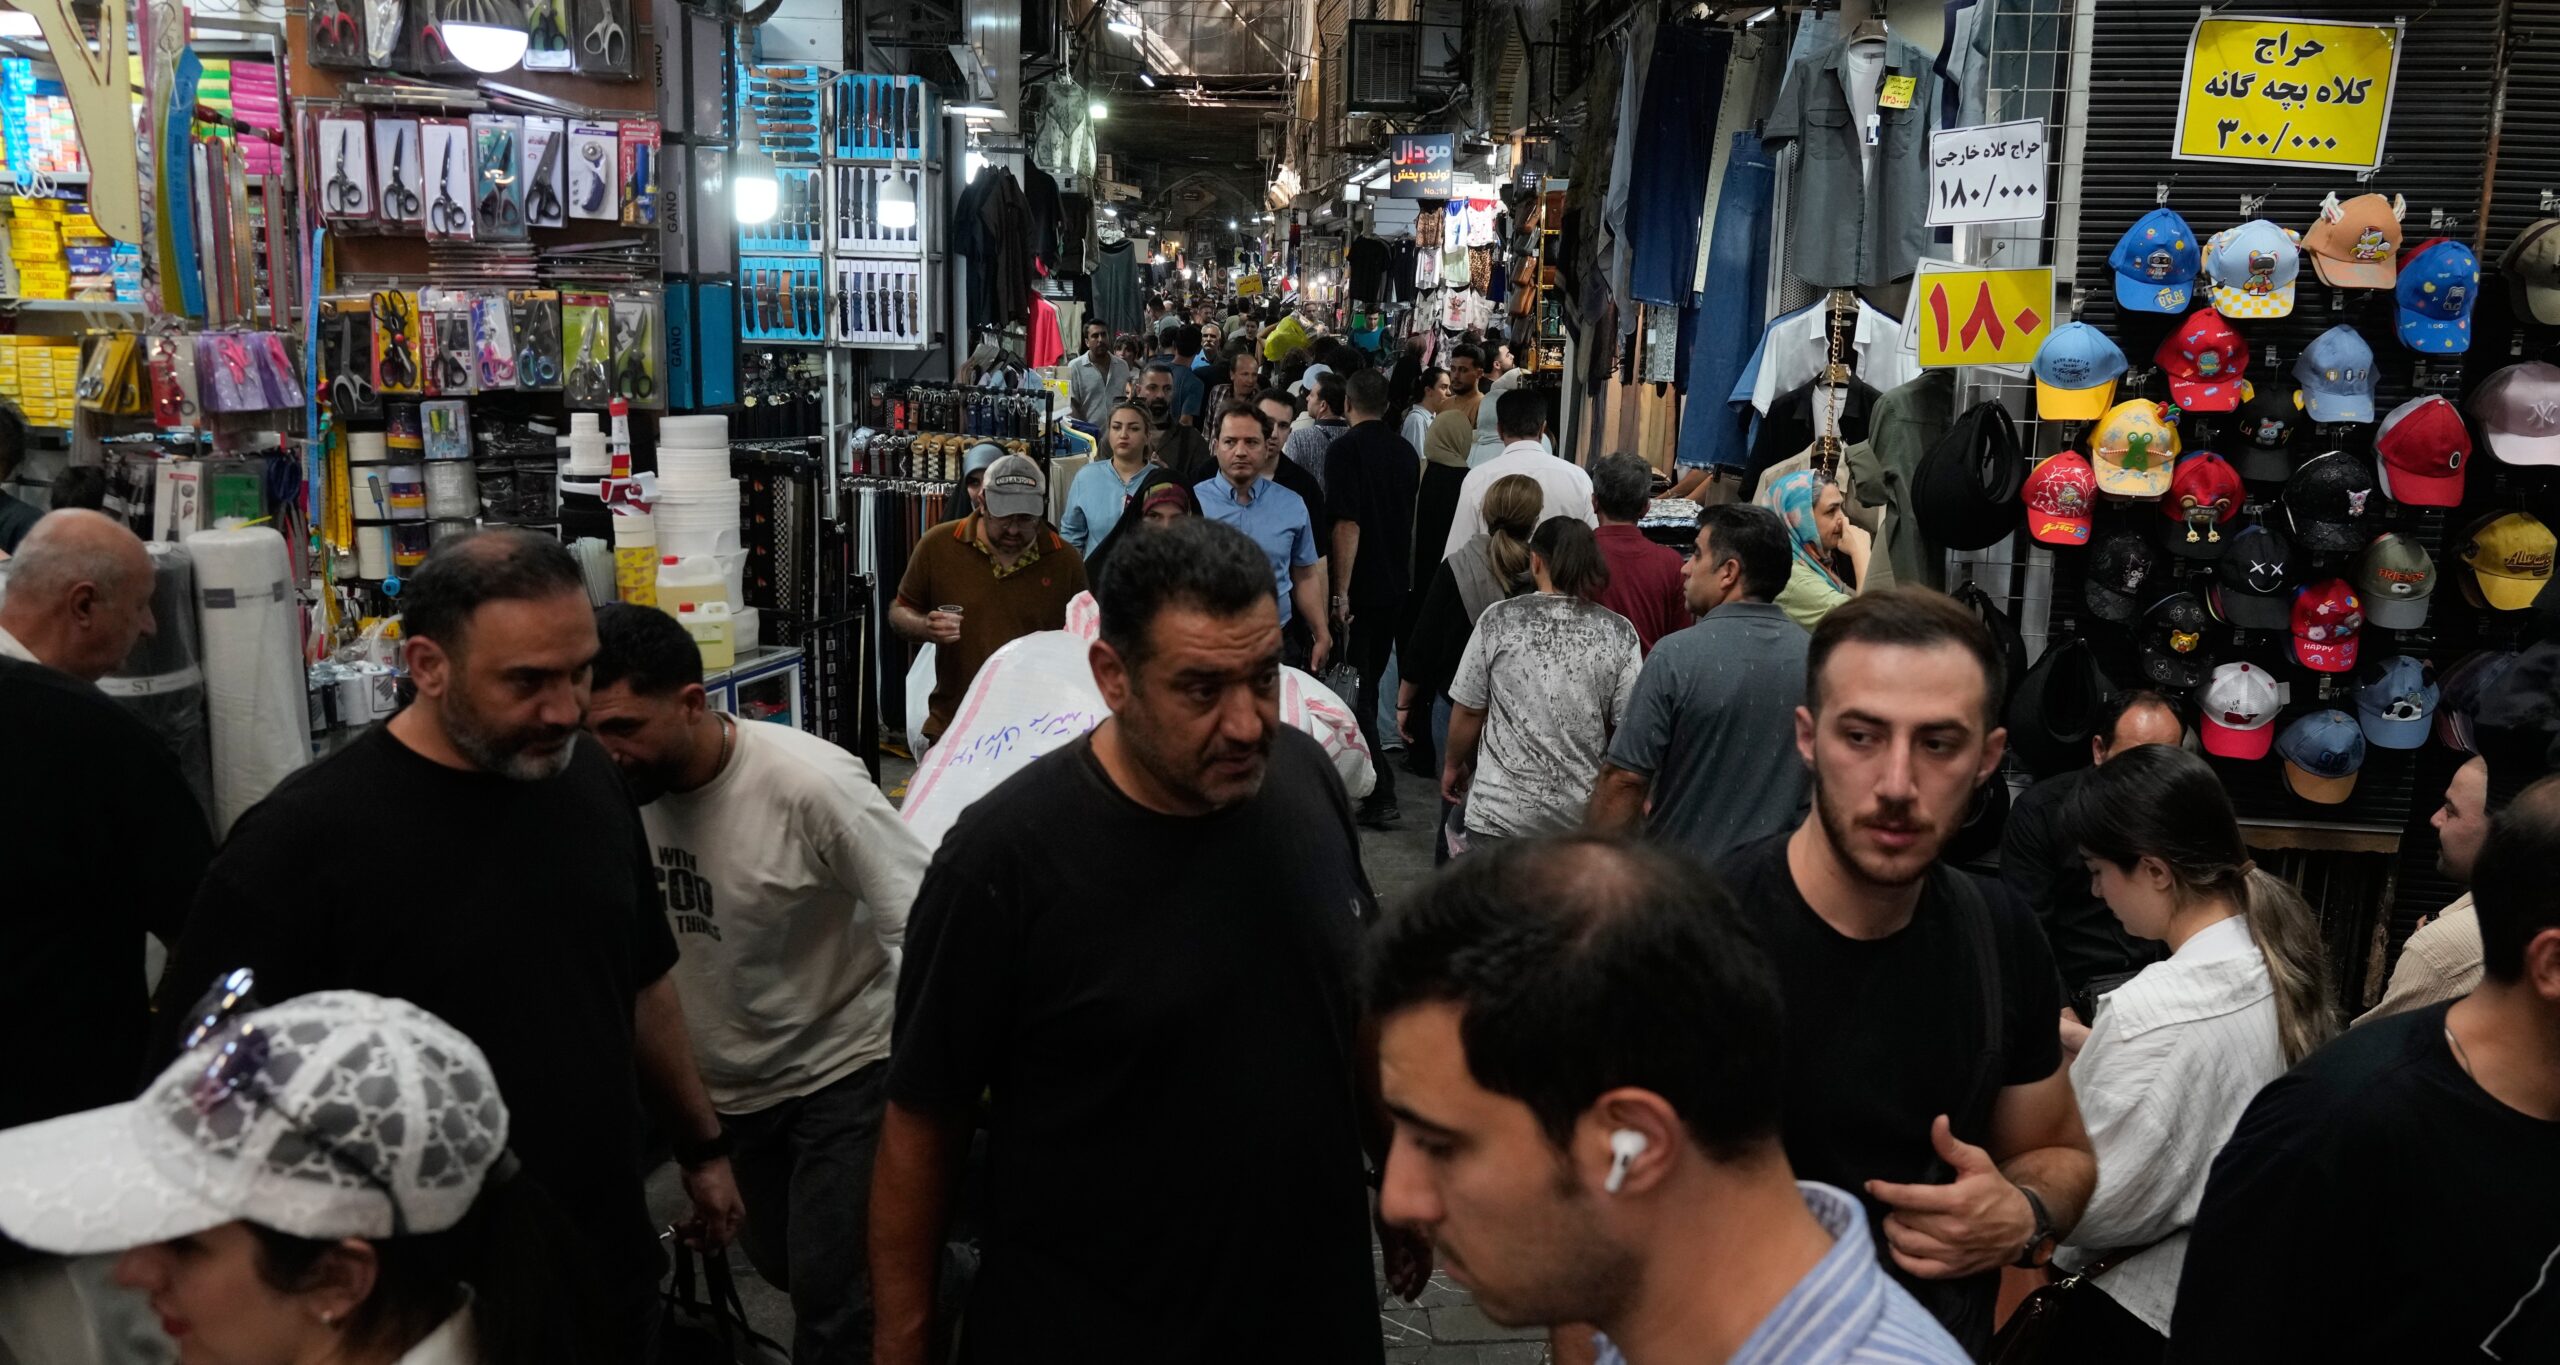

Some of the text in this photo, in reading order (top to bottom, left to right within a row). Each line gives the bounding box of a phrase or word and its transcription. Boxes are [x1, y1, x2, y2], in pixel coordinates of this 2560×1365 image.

[2254, 30, 2324, 66] حراج
[2204, 71, 2372, 111] کلاه بچه گانه
[1935, 139, 2041, 167] حراج کلاه خارجی
[2217, 118, 2337, 154] ۳۰۰/۰۰۰
[1420, 172, 1426, 182] و
[1427, 169, 1450, 182] تولید
[1940, 174, 2038, 210] ۱۸۰/۰۰۰
[666, 191, 678, 232] GANO
[1929, 280, 2042, 353] ۱۸۰
[671, 326, 682, 367] GANO
[2377, 567, 2426, 584] FRIENDS
[2304, 643, 2334, 652] HAPPY
[658, 846, 697, 873] WITH
